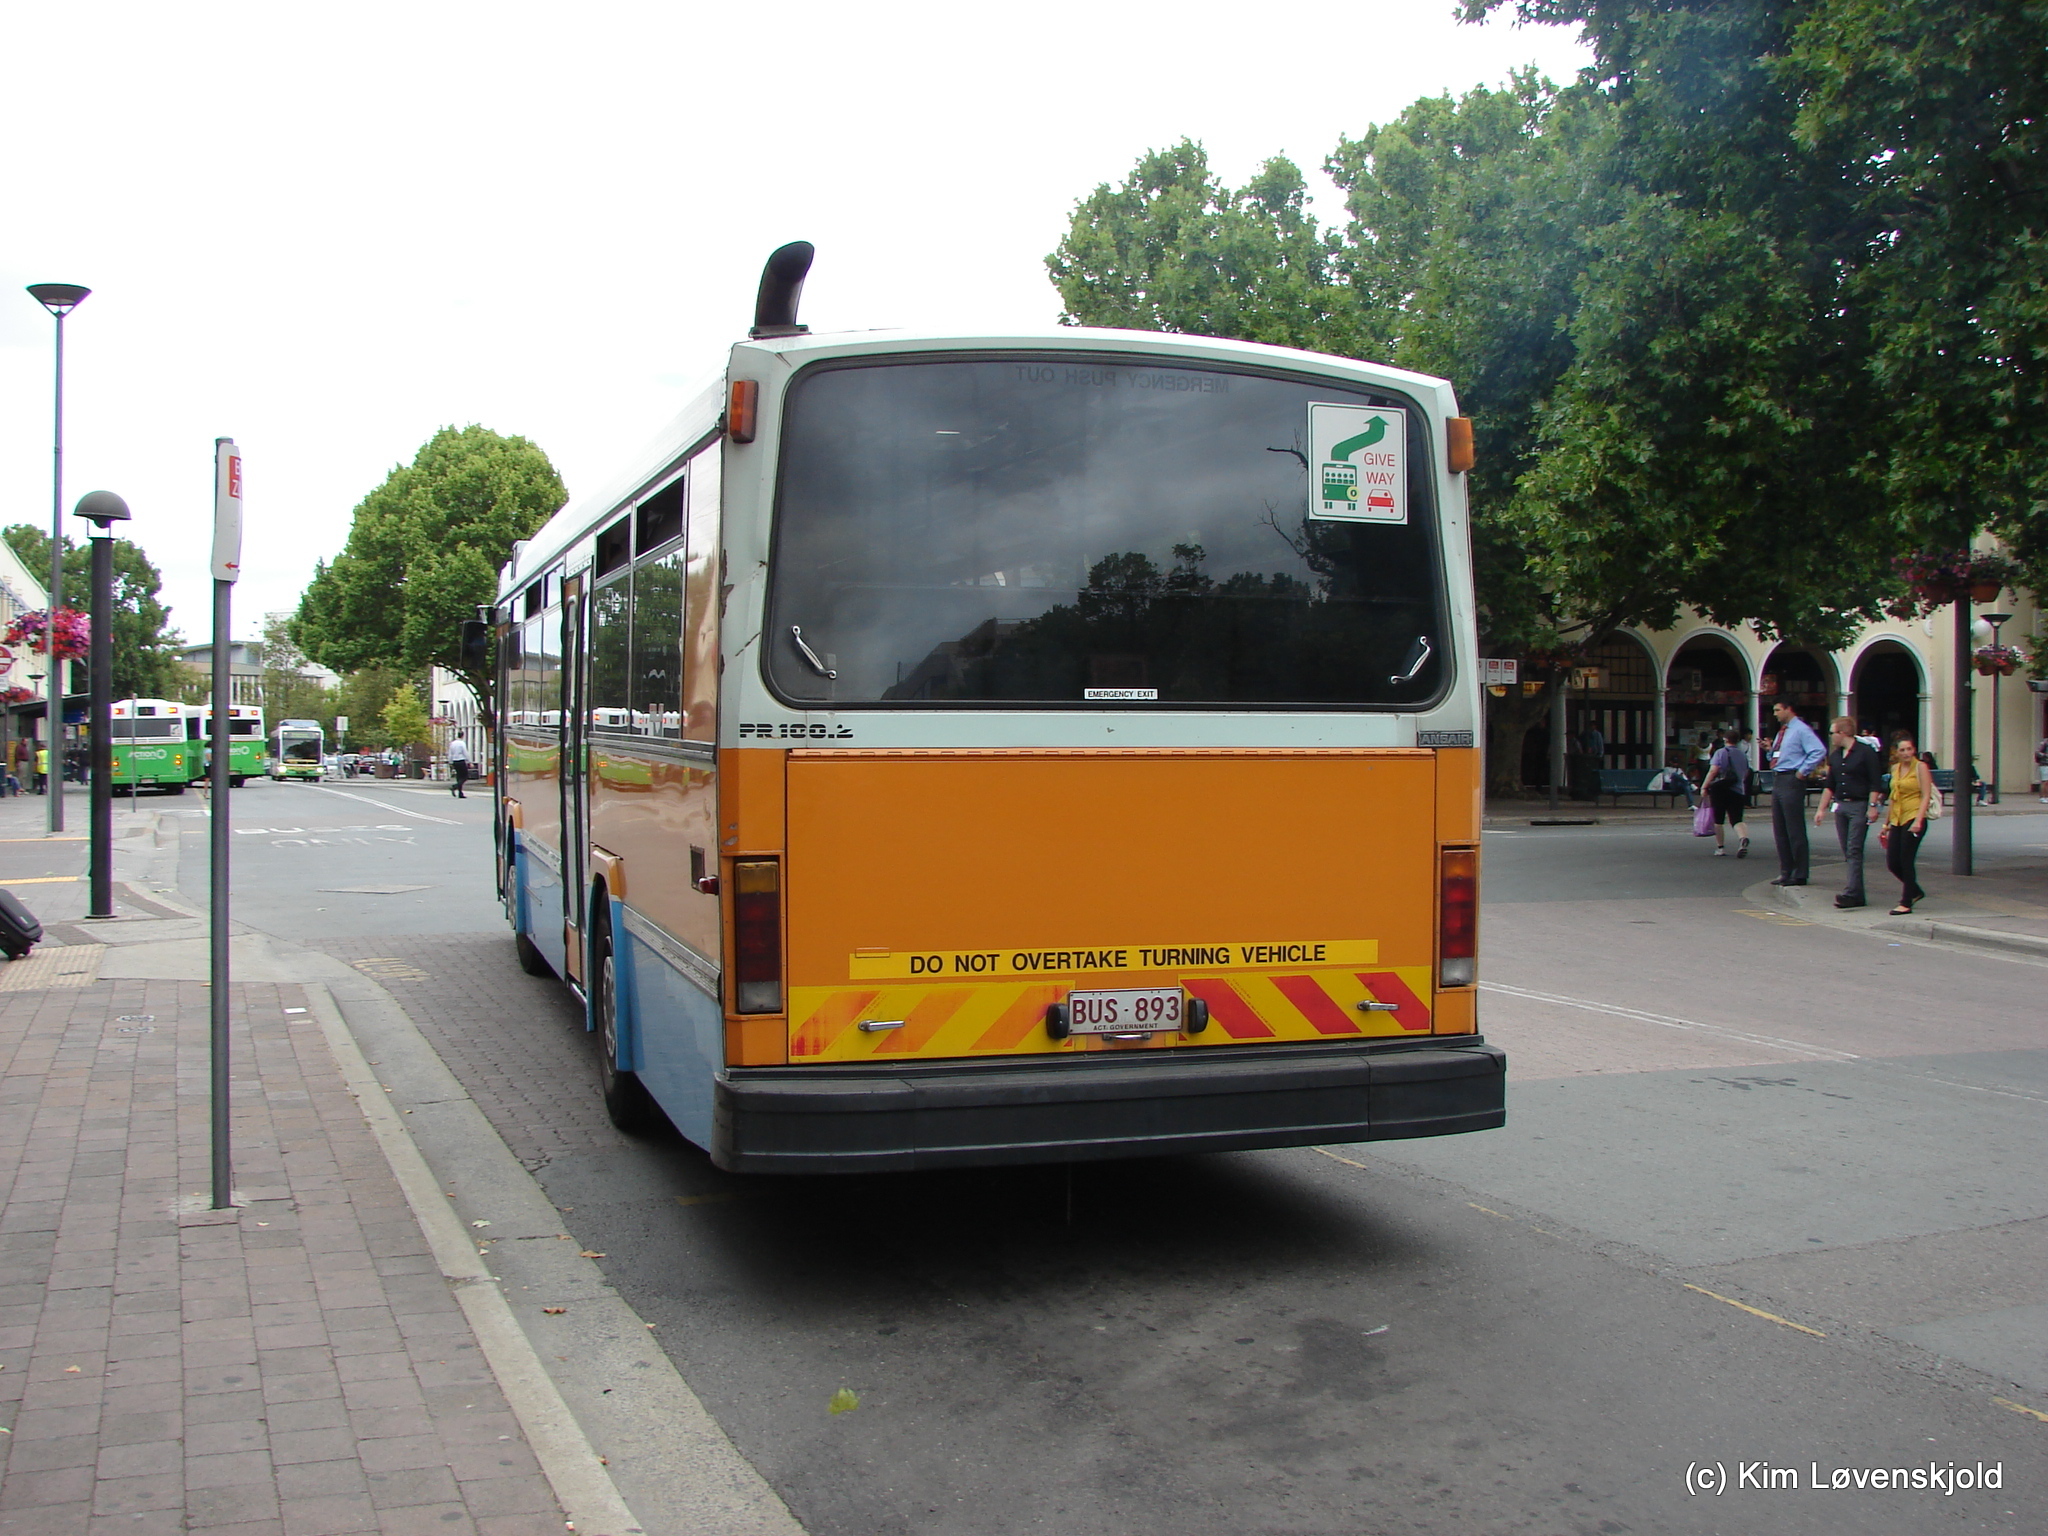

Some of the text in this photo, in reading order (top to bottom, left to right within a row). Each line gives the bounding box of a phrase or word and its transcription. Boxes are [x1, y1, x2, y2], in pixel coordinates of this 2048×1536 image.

[1363, 452, 1396, 467] GIVE
[1366, 471, 1395, 485] WAY
[1087, 690, 1155, 698] EMERGENCY EXIT
[909, 944, 1327, 974] DO NOT OVERTAKE TURNING VEHICLE
[1109, 1022, 1159, 1031] GOVERNMENT
